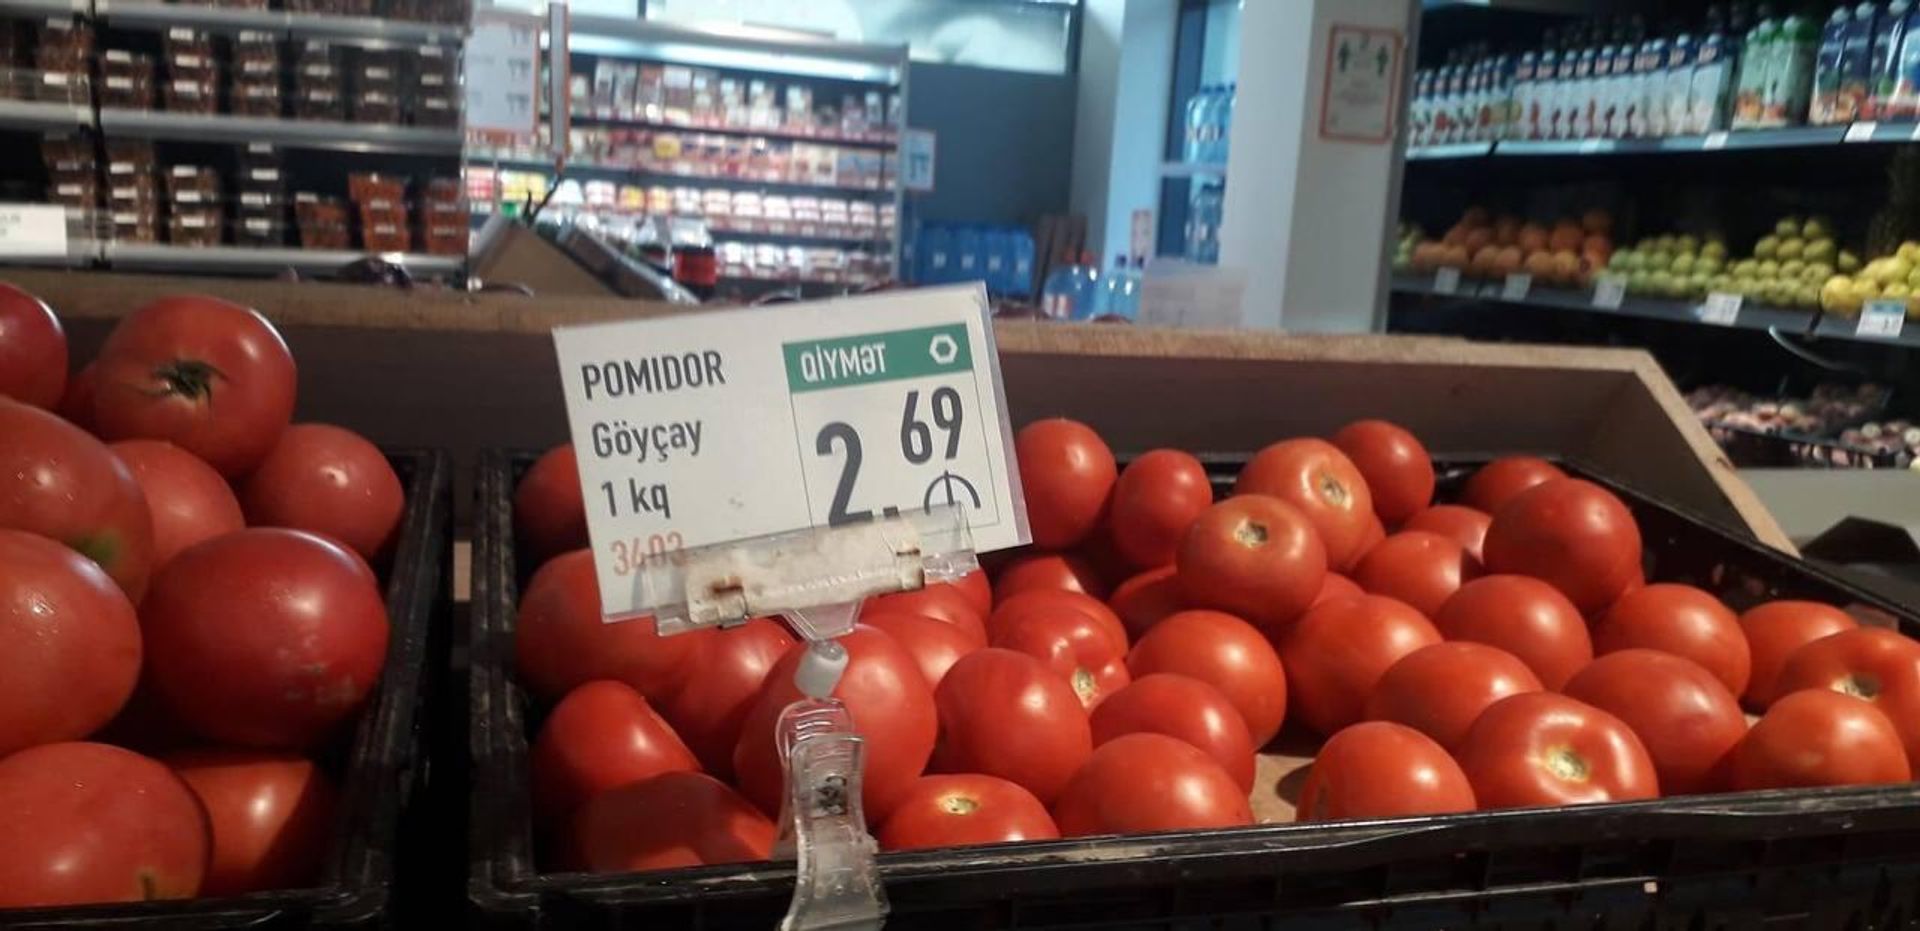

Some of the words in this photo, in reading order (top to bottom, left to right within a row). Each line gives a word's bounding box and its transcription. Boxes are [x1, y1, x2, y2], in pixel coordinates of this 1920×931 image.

[581, 350, 727, 400] POMIDOR
[592, 418, 703, 463] Göyçay
[899, 386, 964, 466] 69
[601, 481, 618, 517] 1
[629, 476, 671, 519] kq
